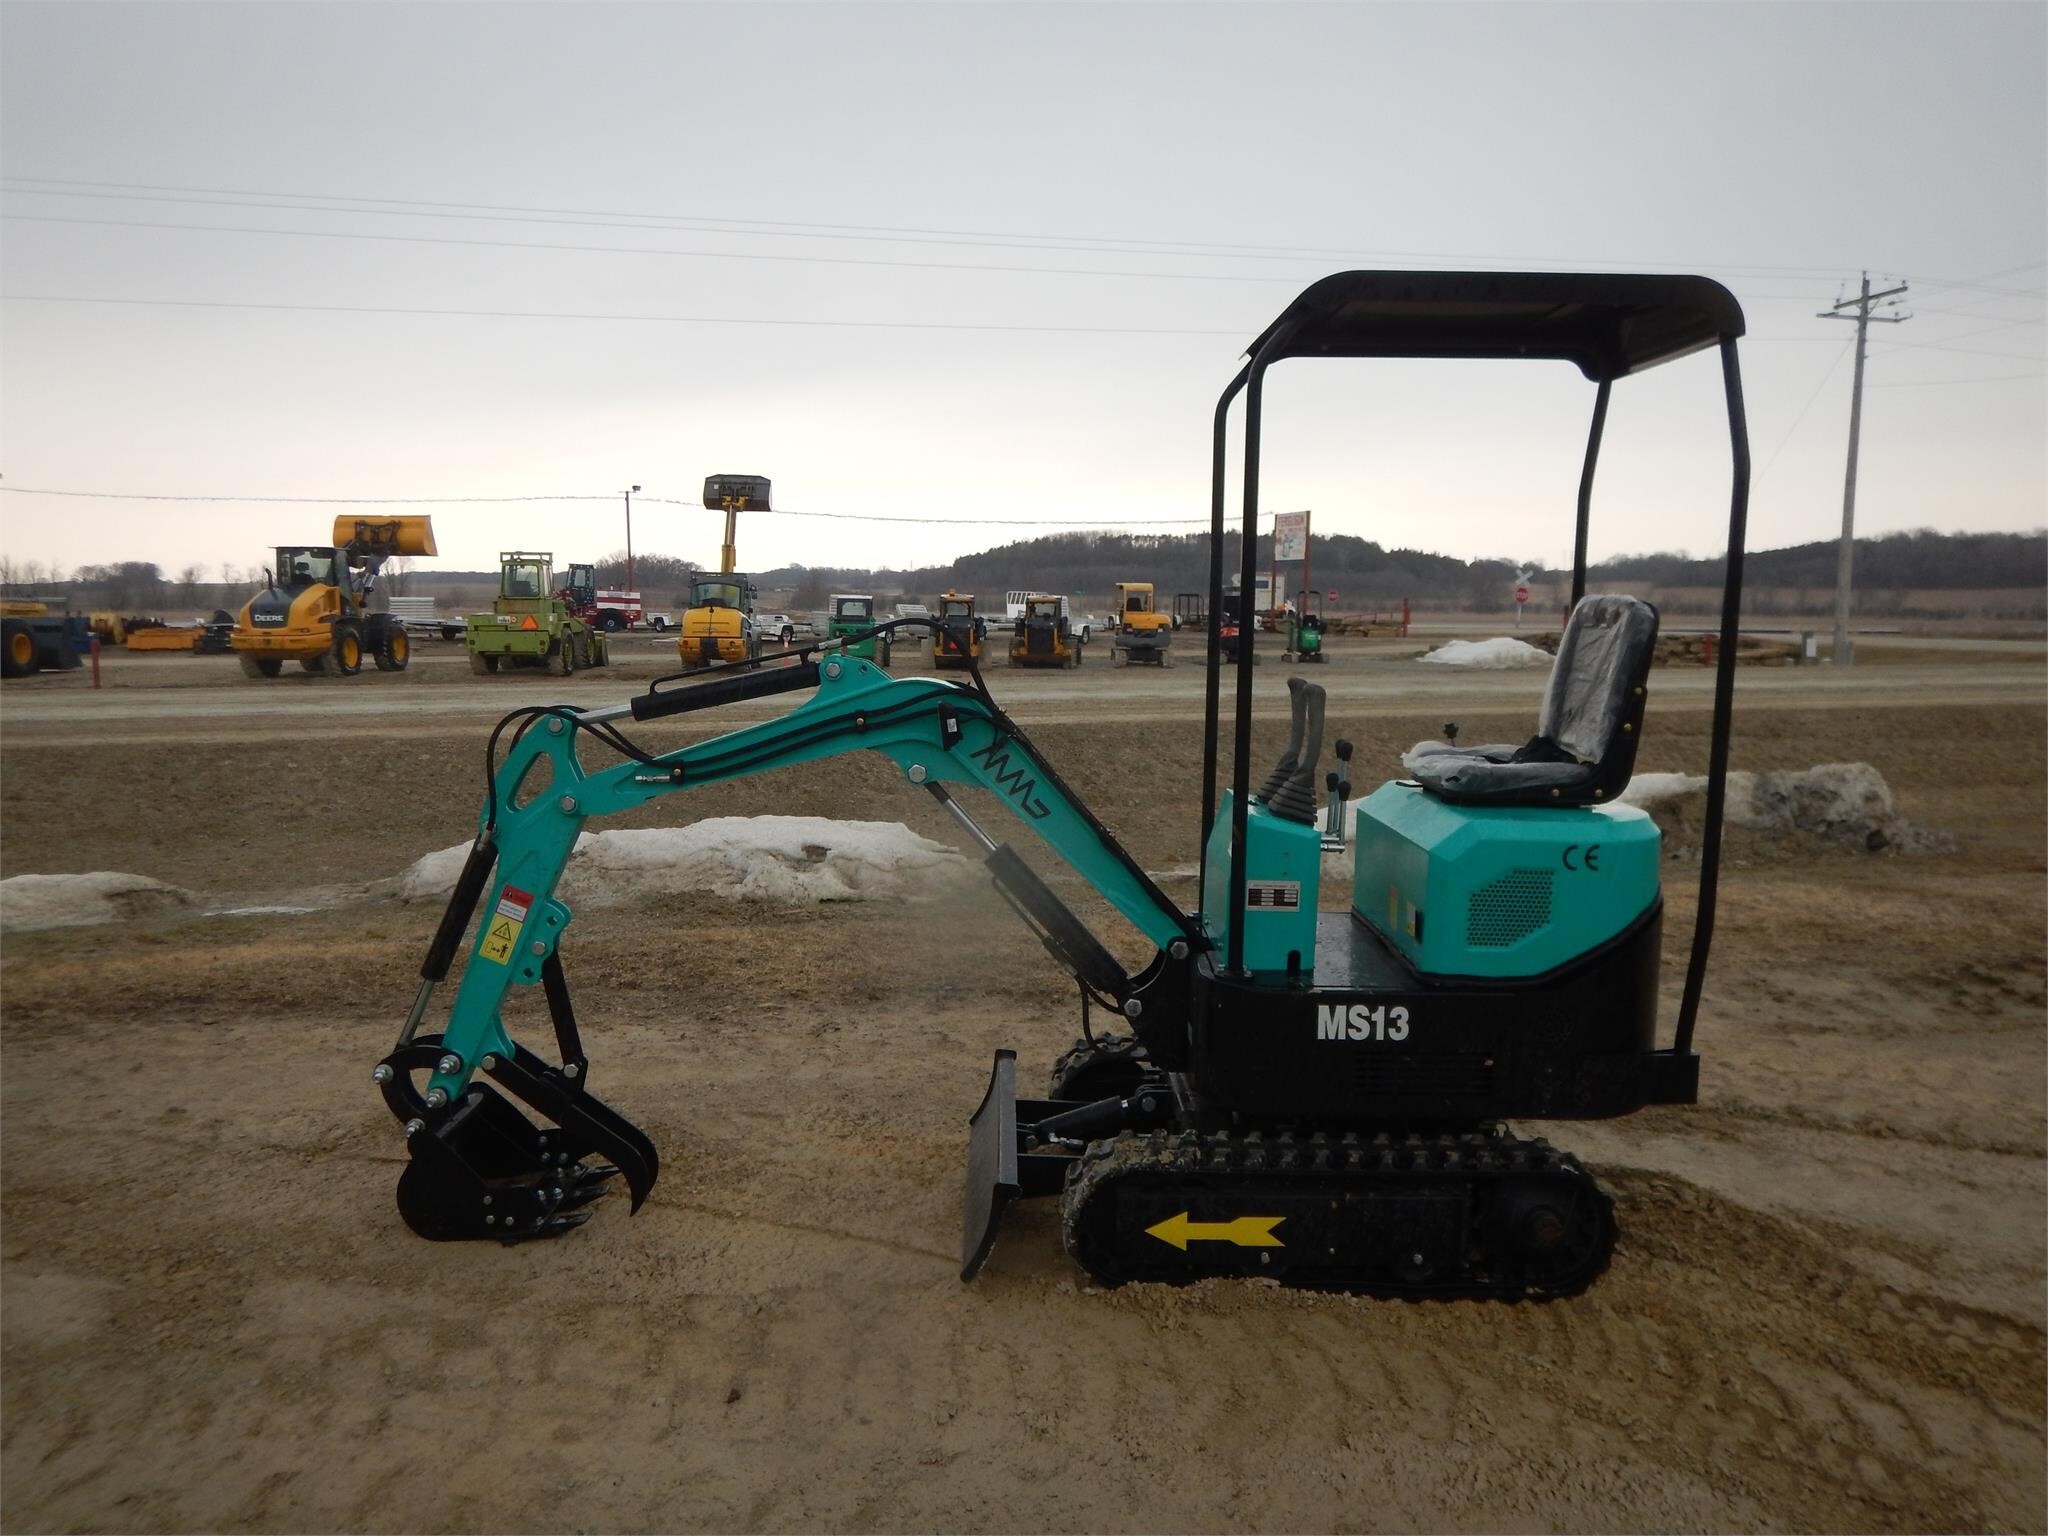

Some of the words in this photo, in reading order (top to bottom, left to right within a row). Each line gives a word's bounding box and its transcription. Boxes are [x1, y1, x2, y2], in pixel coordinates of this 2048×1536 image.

[254, 614, 284, 622] DEERE
[1562, 844, 1600, 871] CE
[1317, 1004, 1410, 1041] MS13
